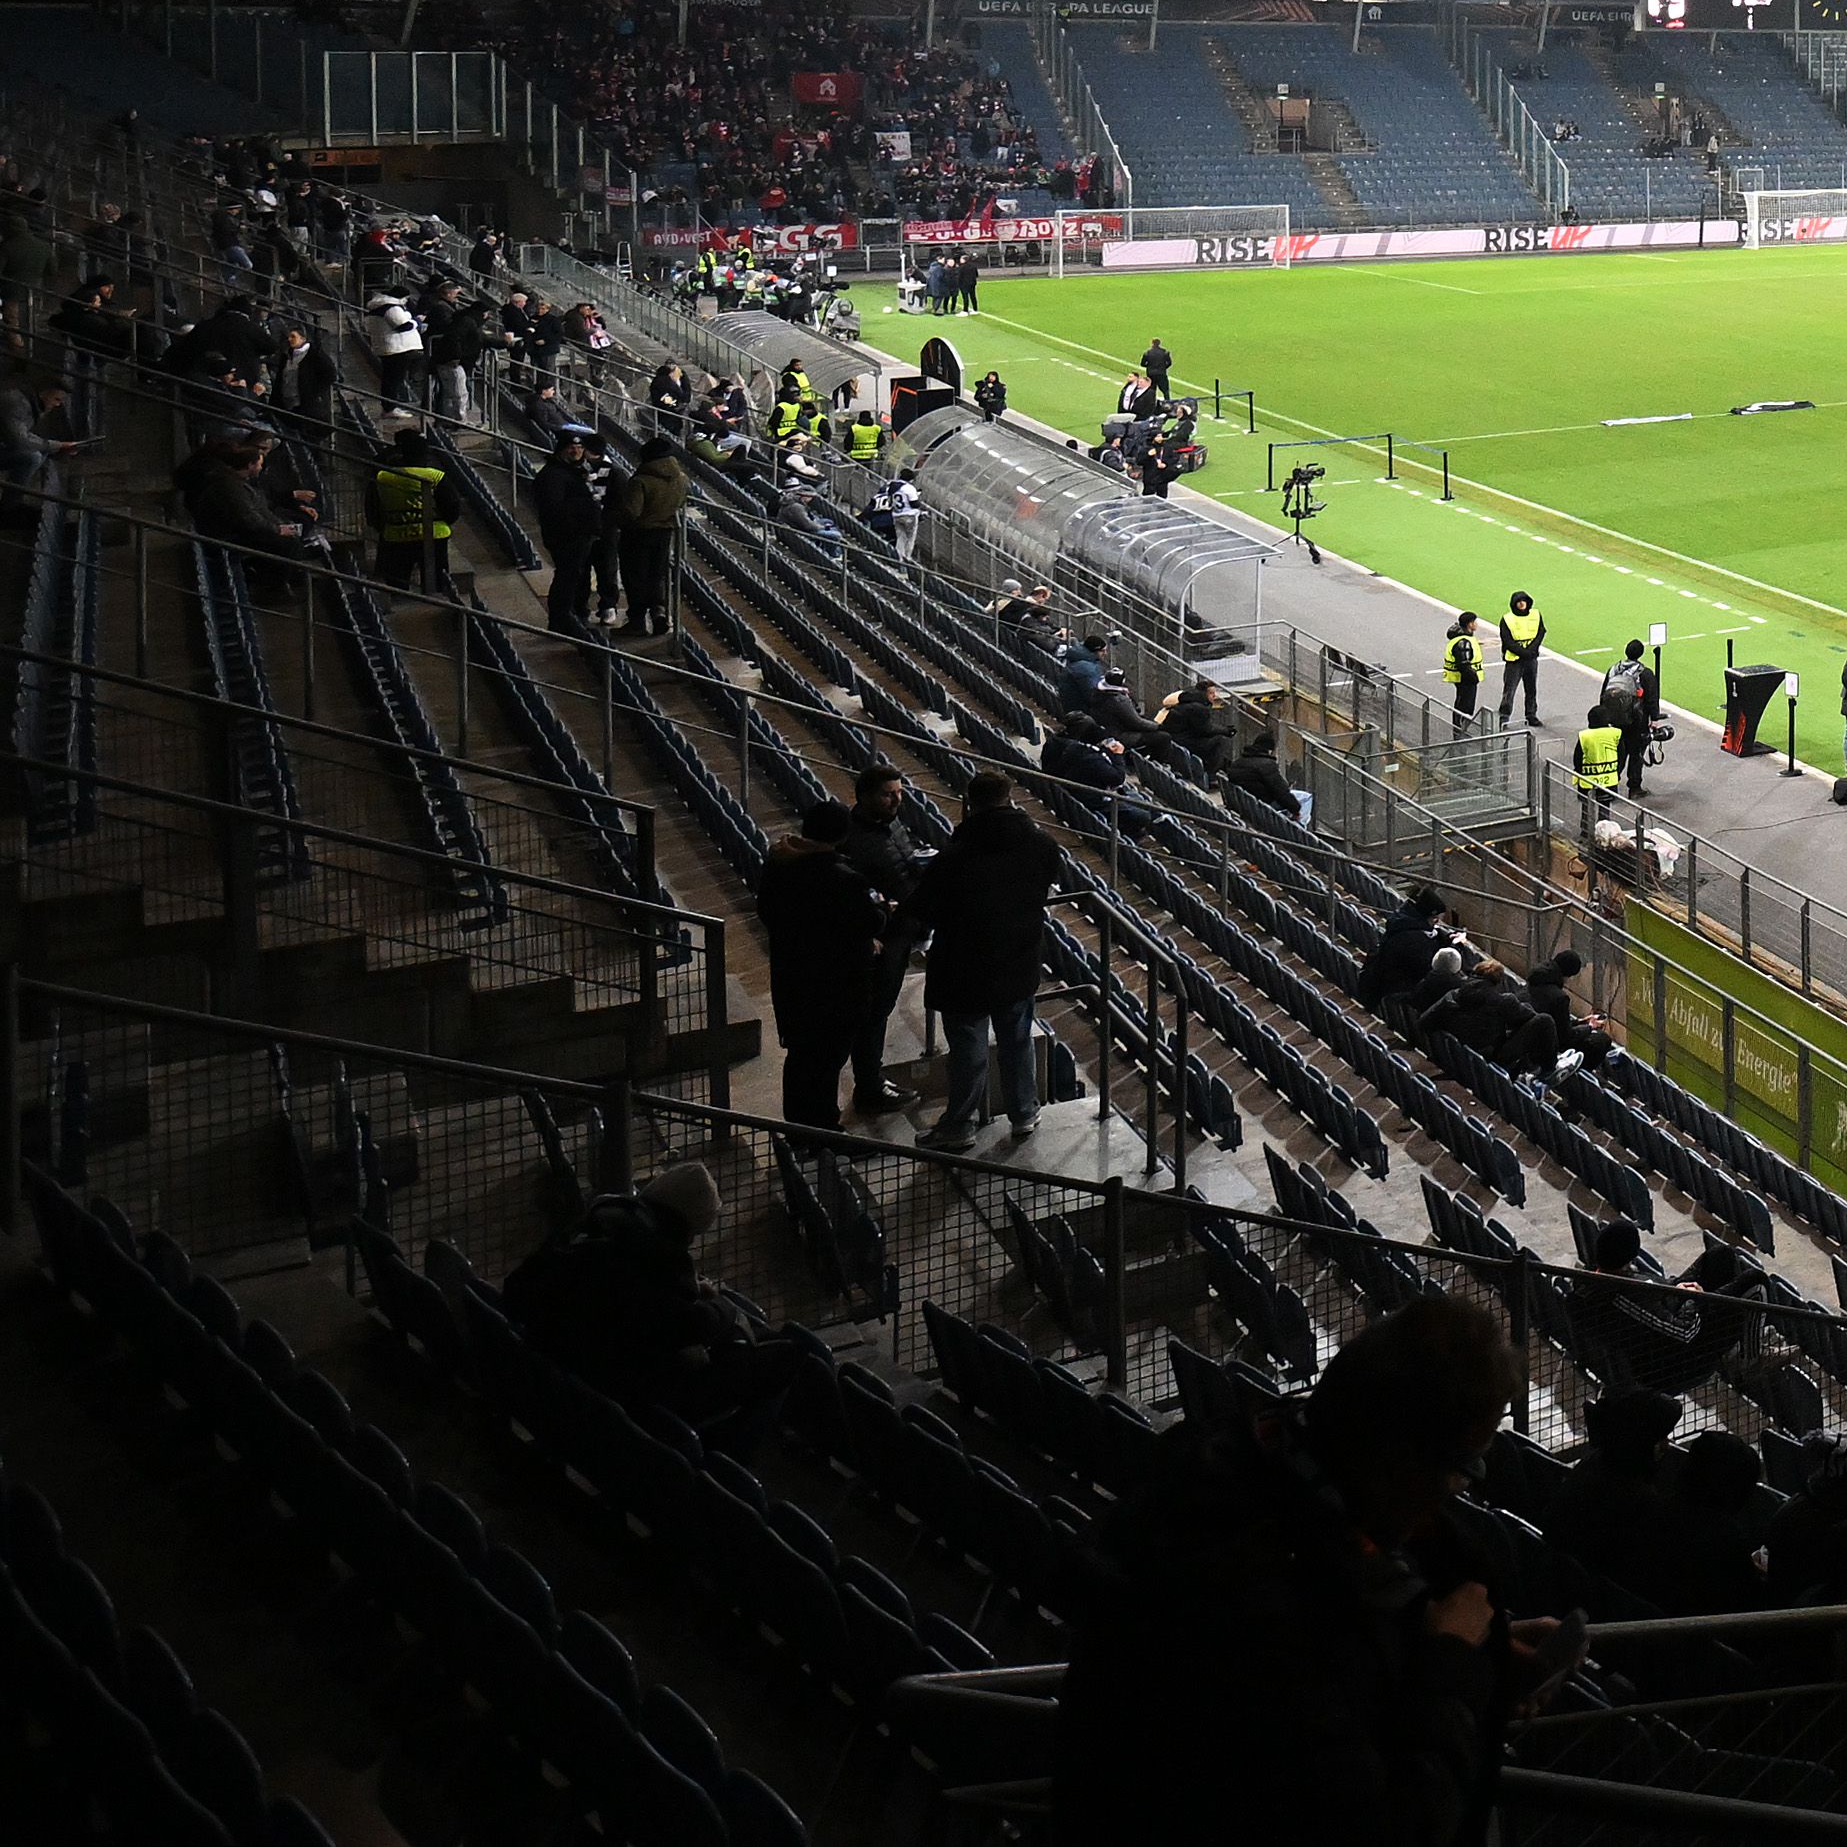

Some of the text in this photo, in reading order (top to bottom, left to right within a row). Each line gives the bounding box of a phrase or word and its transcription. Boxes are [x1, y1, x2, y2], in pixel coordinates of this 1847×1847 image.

[979, 0, 1020, 12] UEFA
[1094, 2, 1154, 15] LEAGUE
[1572, 10, 1606, 21] UEFA
[1484, 225, 1593, 252] RISE UP
[1796, 217, 1834, 240] UP
[1197, 235, 1321, 264] RISE UP
[1669, 997, 1709, 1041] Abfall
